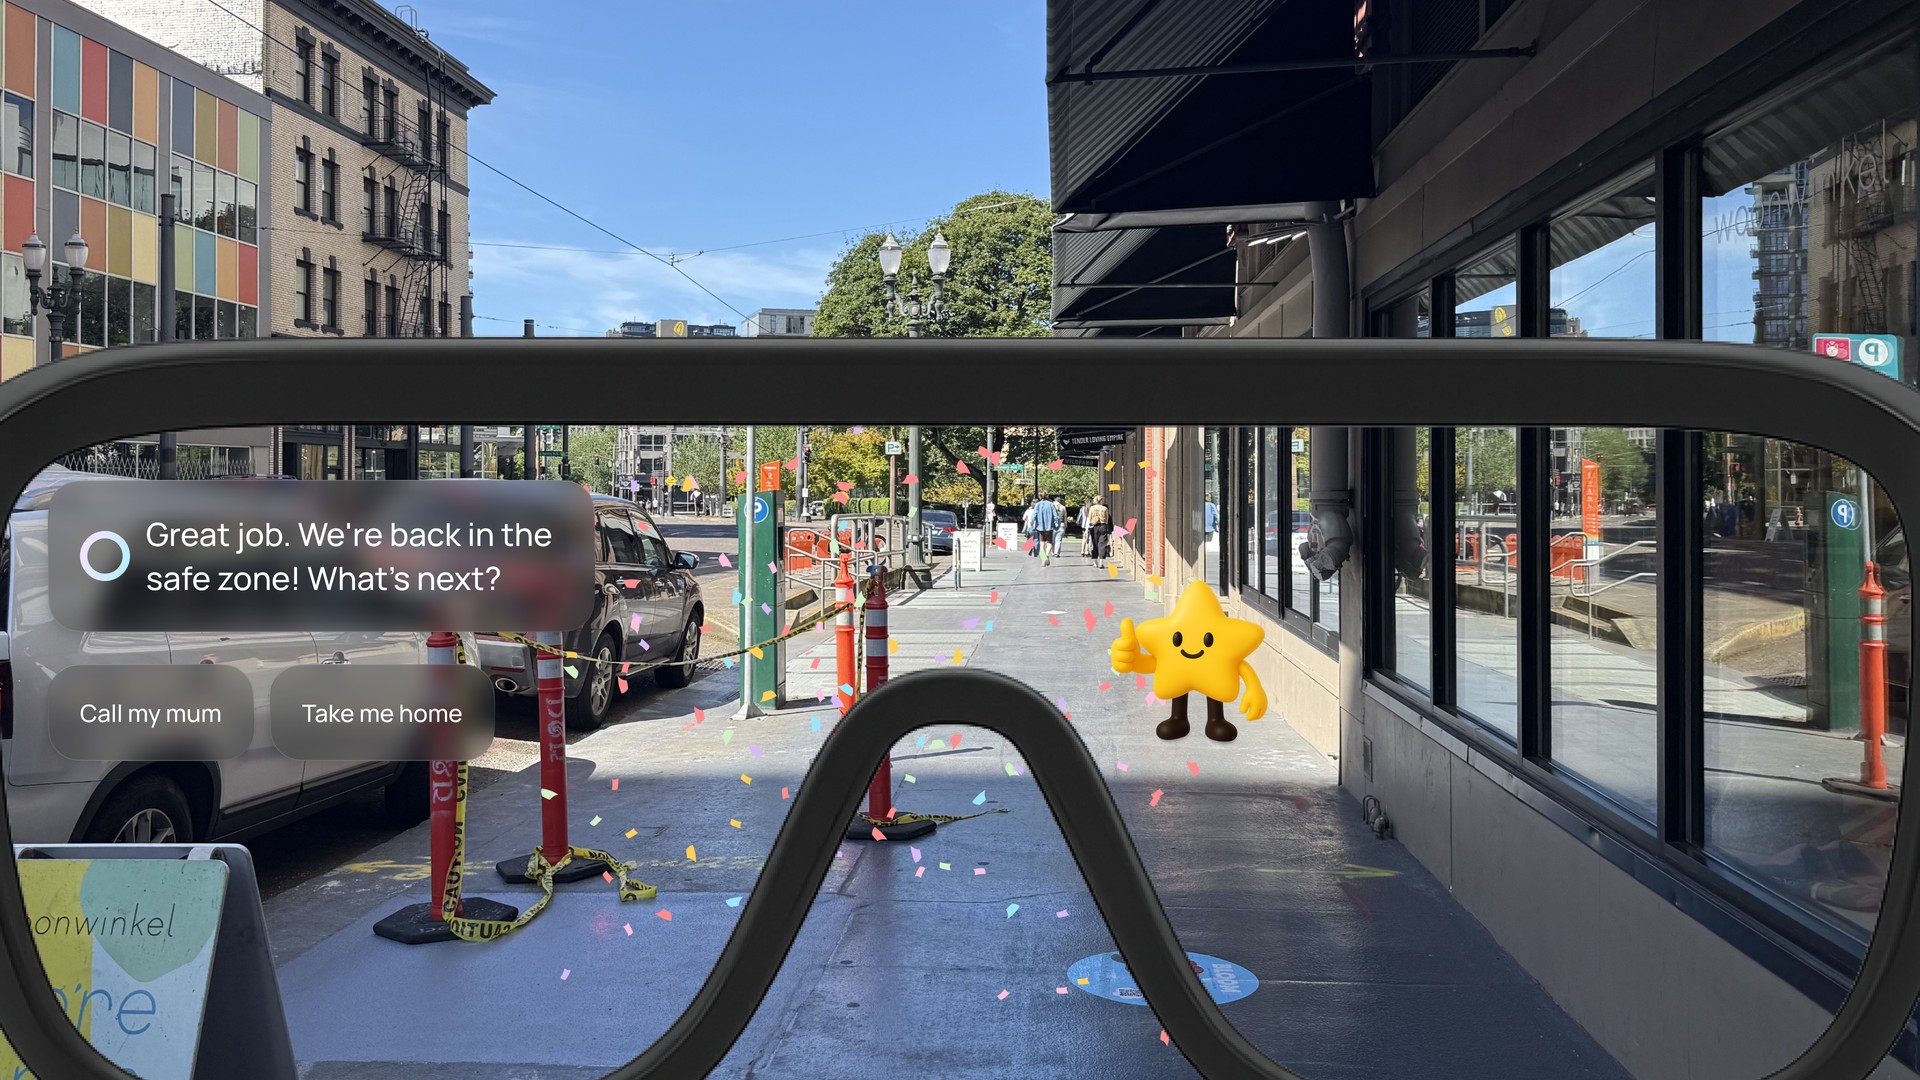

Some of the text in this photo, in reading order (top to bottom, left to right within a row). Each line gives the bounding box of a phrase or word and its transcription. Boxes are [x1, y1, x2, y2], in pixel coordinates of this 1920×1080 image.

[1071, 433, 1124, 445] TENDER LOVING EMPIRE
[28, 903, 176, 938] onwinkel
[1212, 963, 1242, 993] BLOOM
